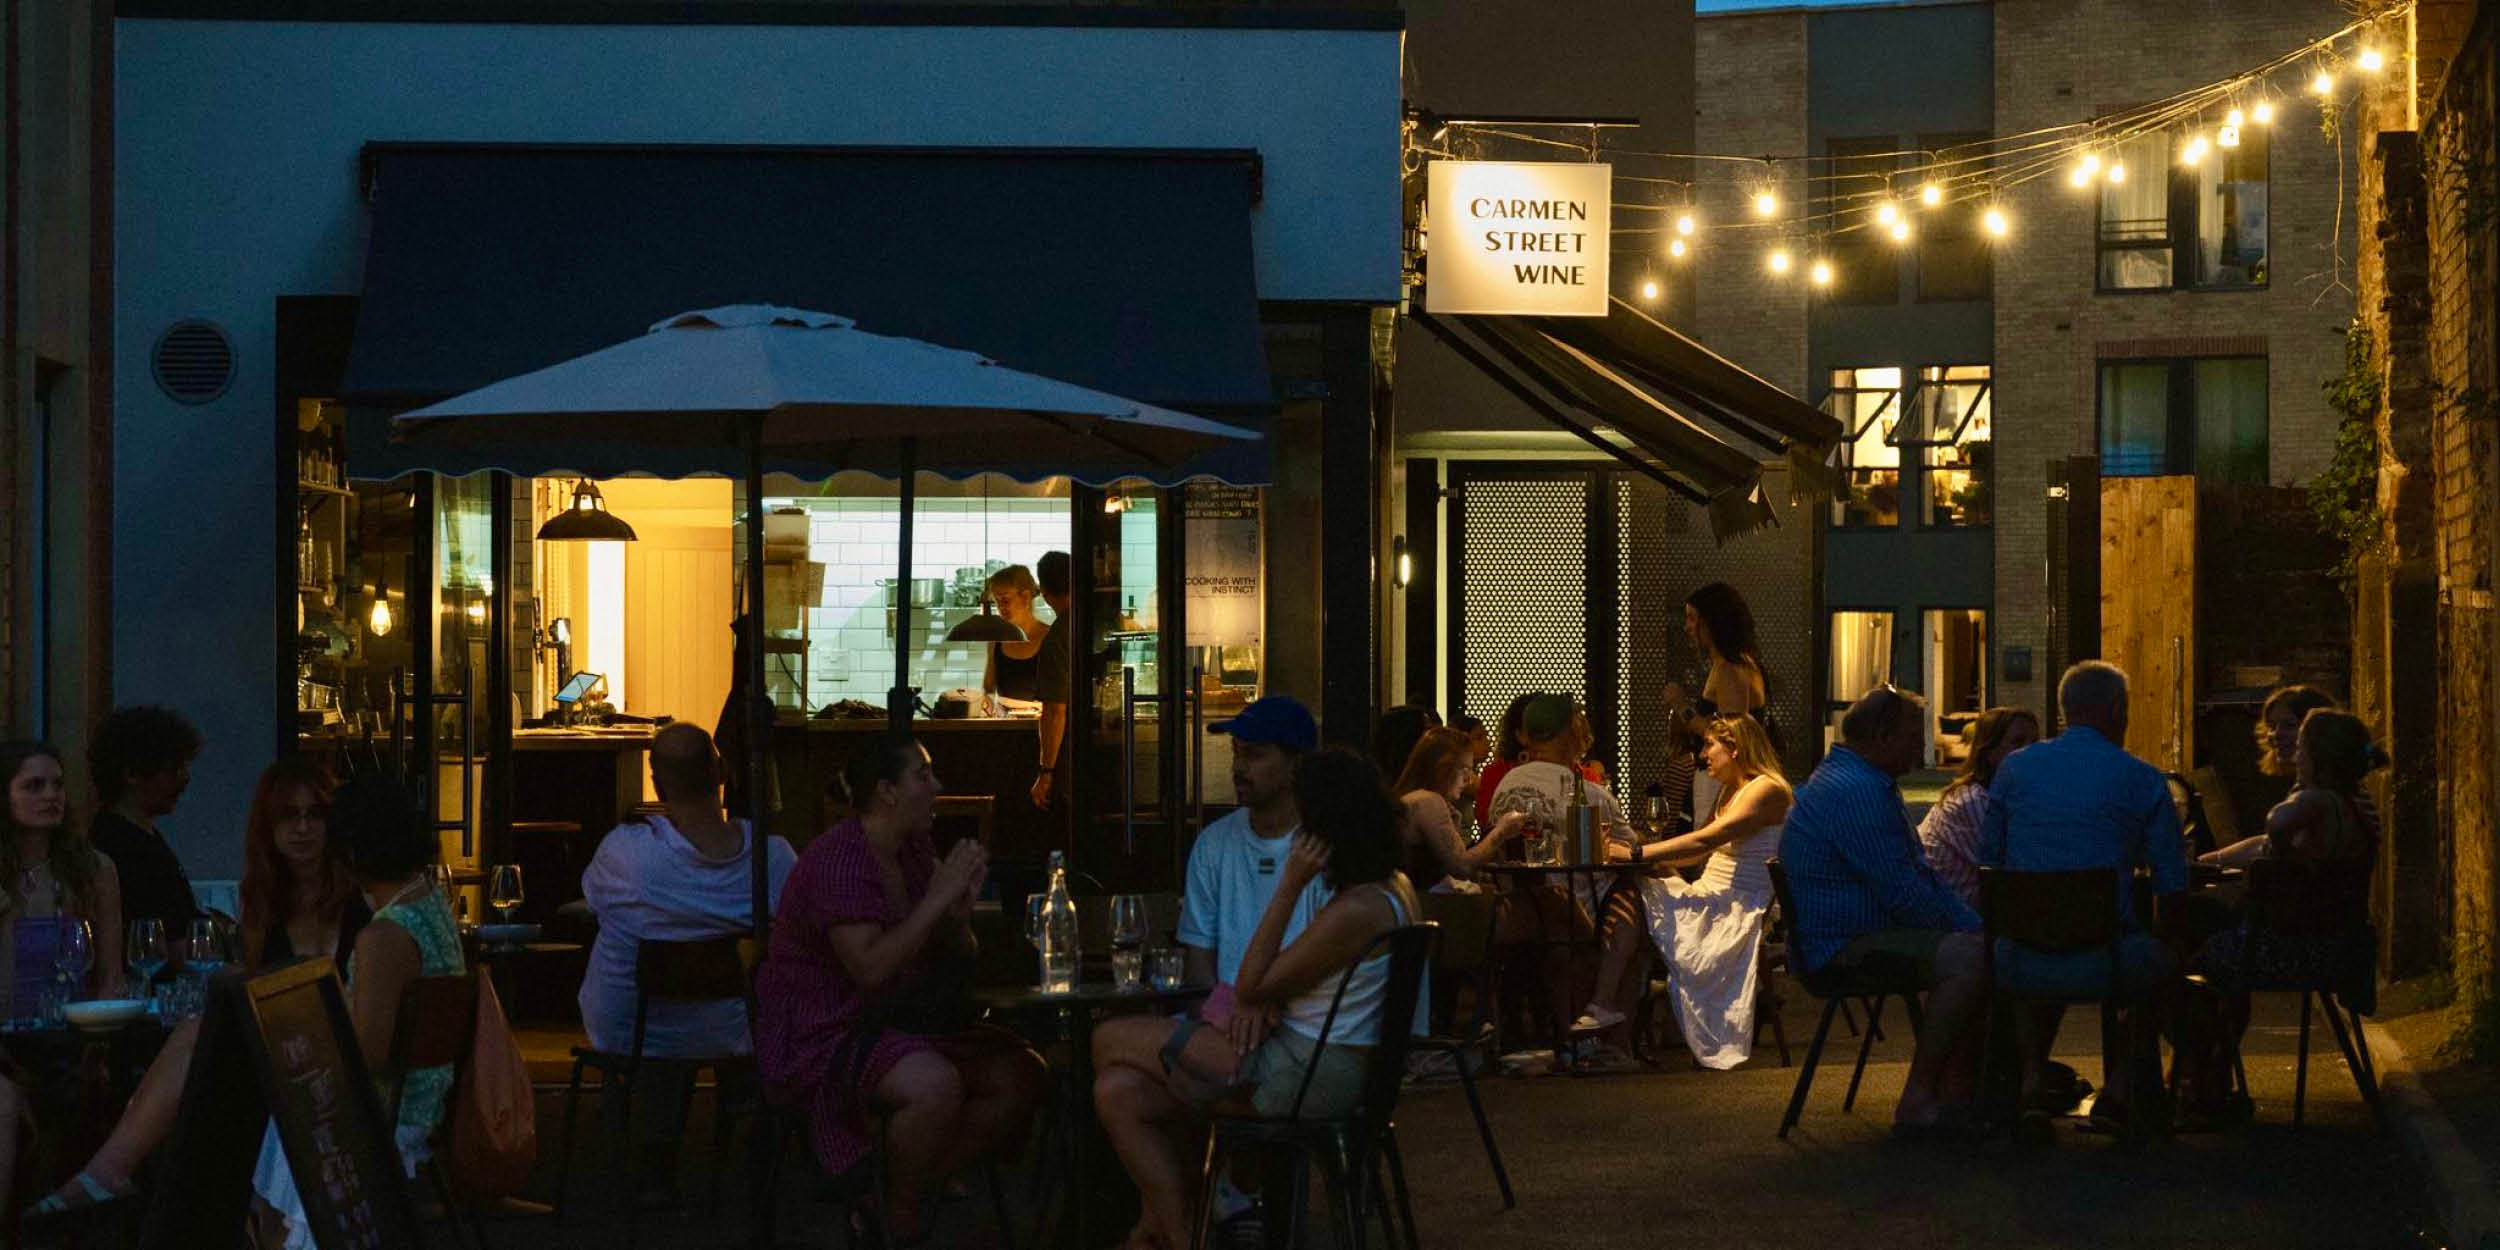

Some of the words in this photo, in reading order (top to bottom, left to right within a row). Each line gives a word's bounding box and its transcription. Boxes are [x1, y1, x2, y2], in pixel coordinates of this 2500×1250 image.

[1471, 198, 1586, 220] CARMEN
[1486, 231, 1586, 253] STREET
[1514, 264, 1585, 285] WINE
[1185, 576, 1229, 585] COOKING
[1231, 576, 1256, 585] WITH
[1211, 585, 1255, 593] INSTINCT
